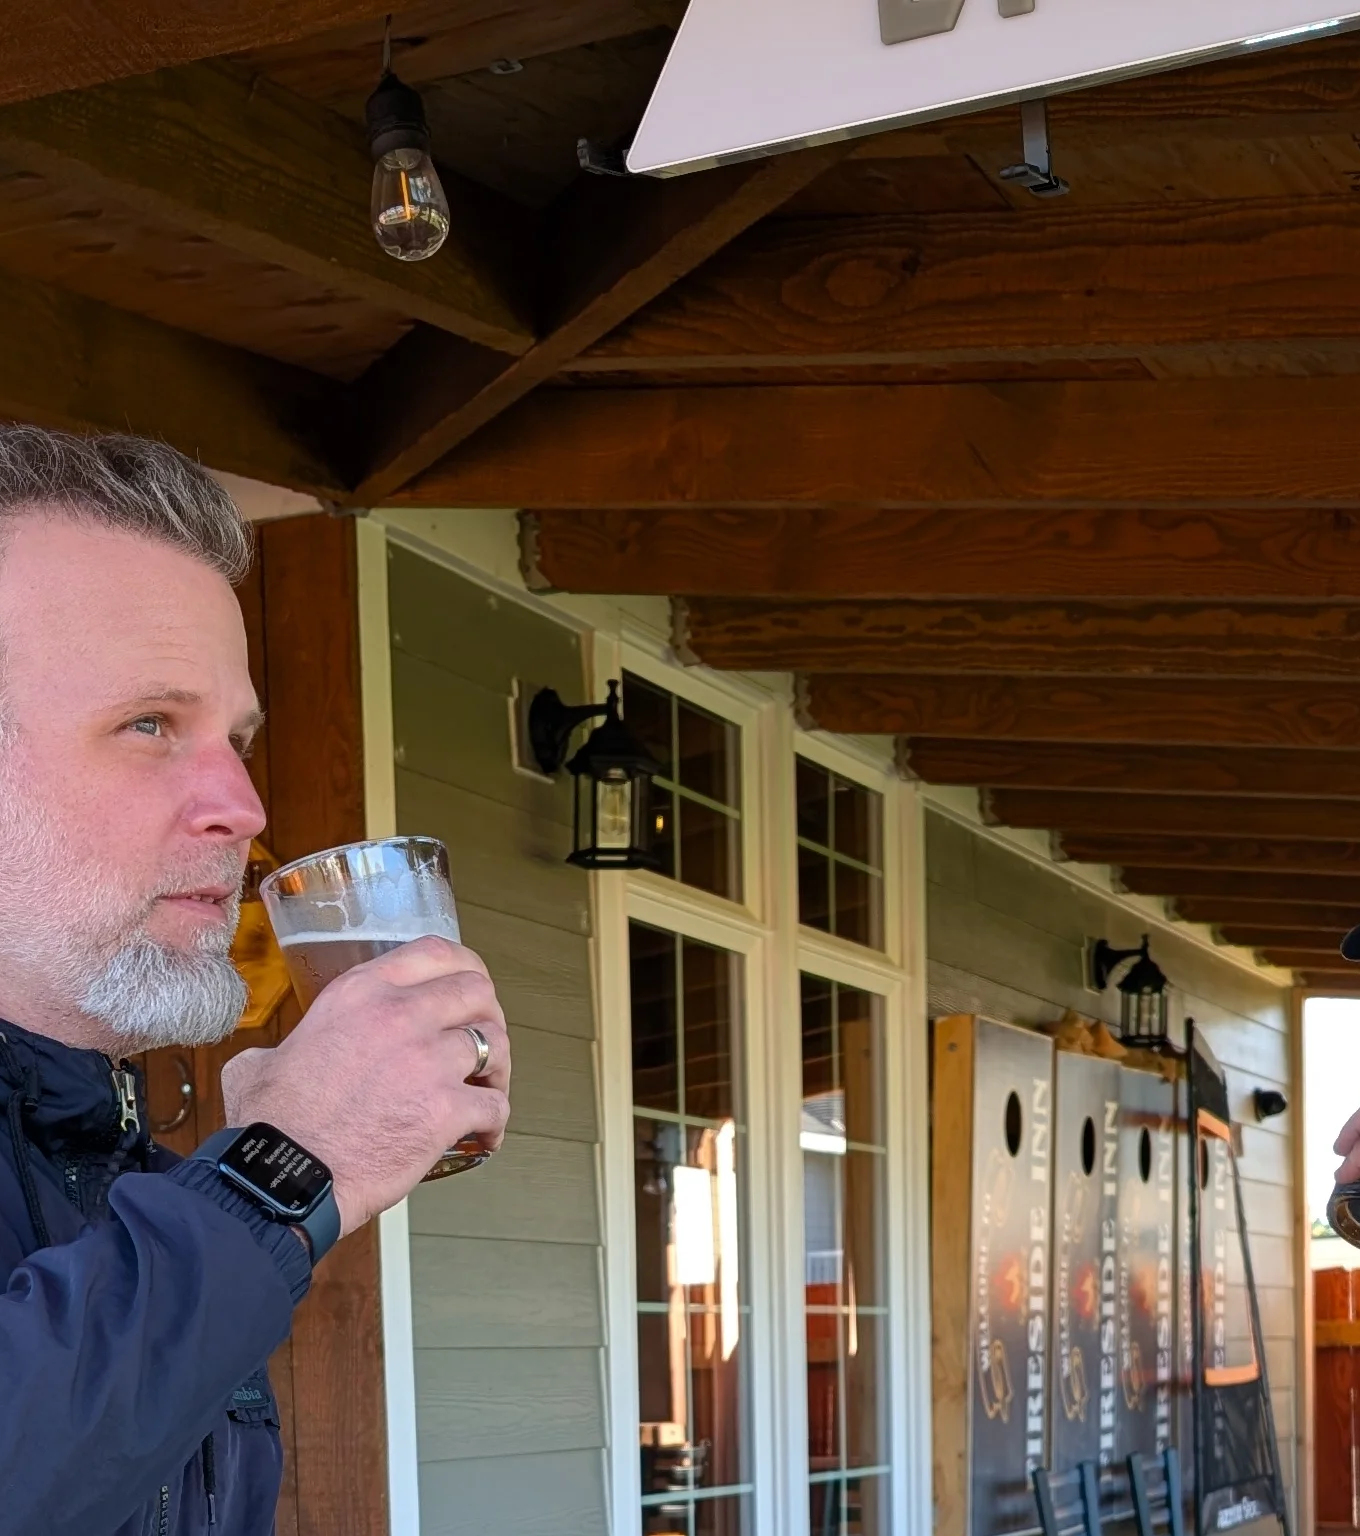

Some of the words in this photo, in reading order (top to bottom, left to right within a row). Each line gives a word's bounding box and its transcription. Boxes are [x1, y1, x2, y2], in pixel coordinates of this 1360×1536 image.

[293, 1158, 312, 1177] Battery
[1032, 1079, 1049, 1182] INN
[1103, 1100, 1118, 1196] INN
